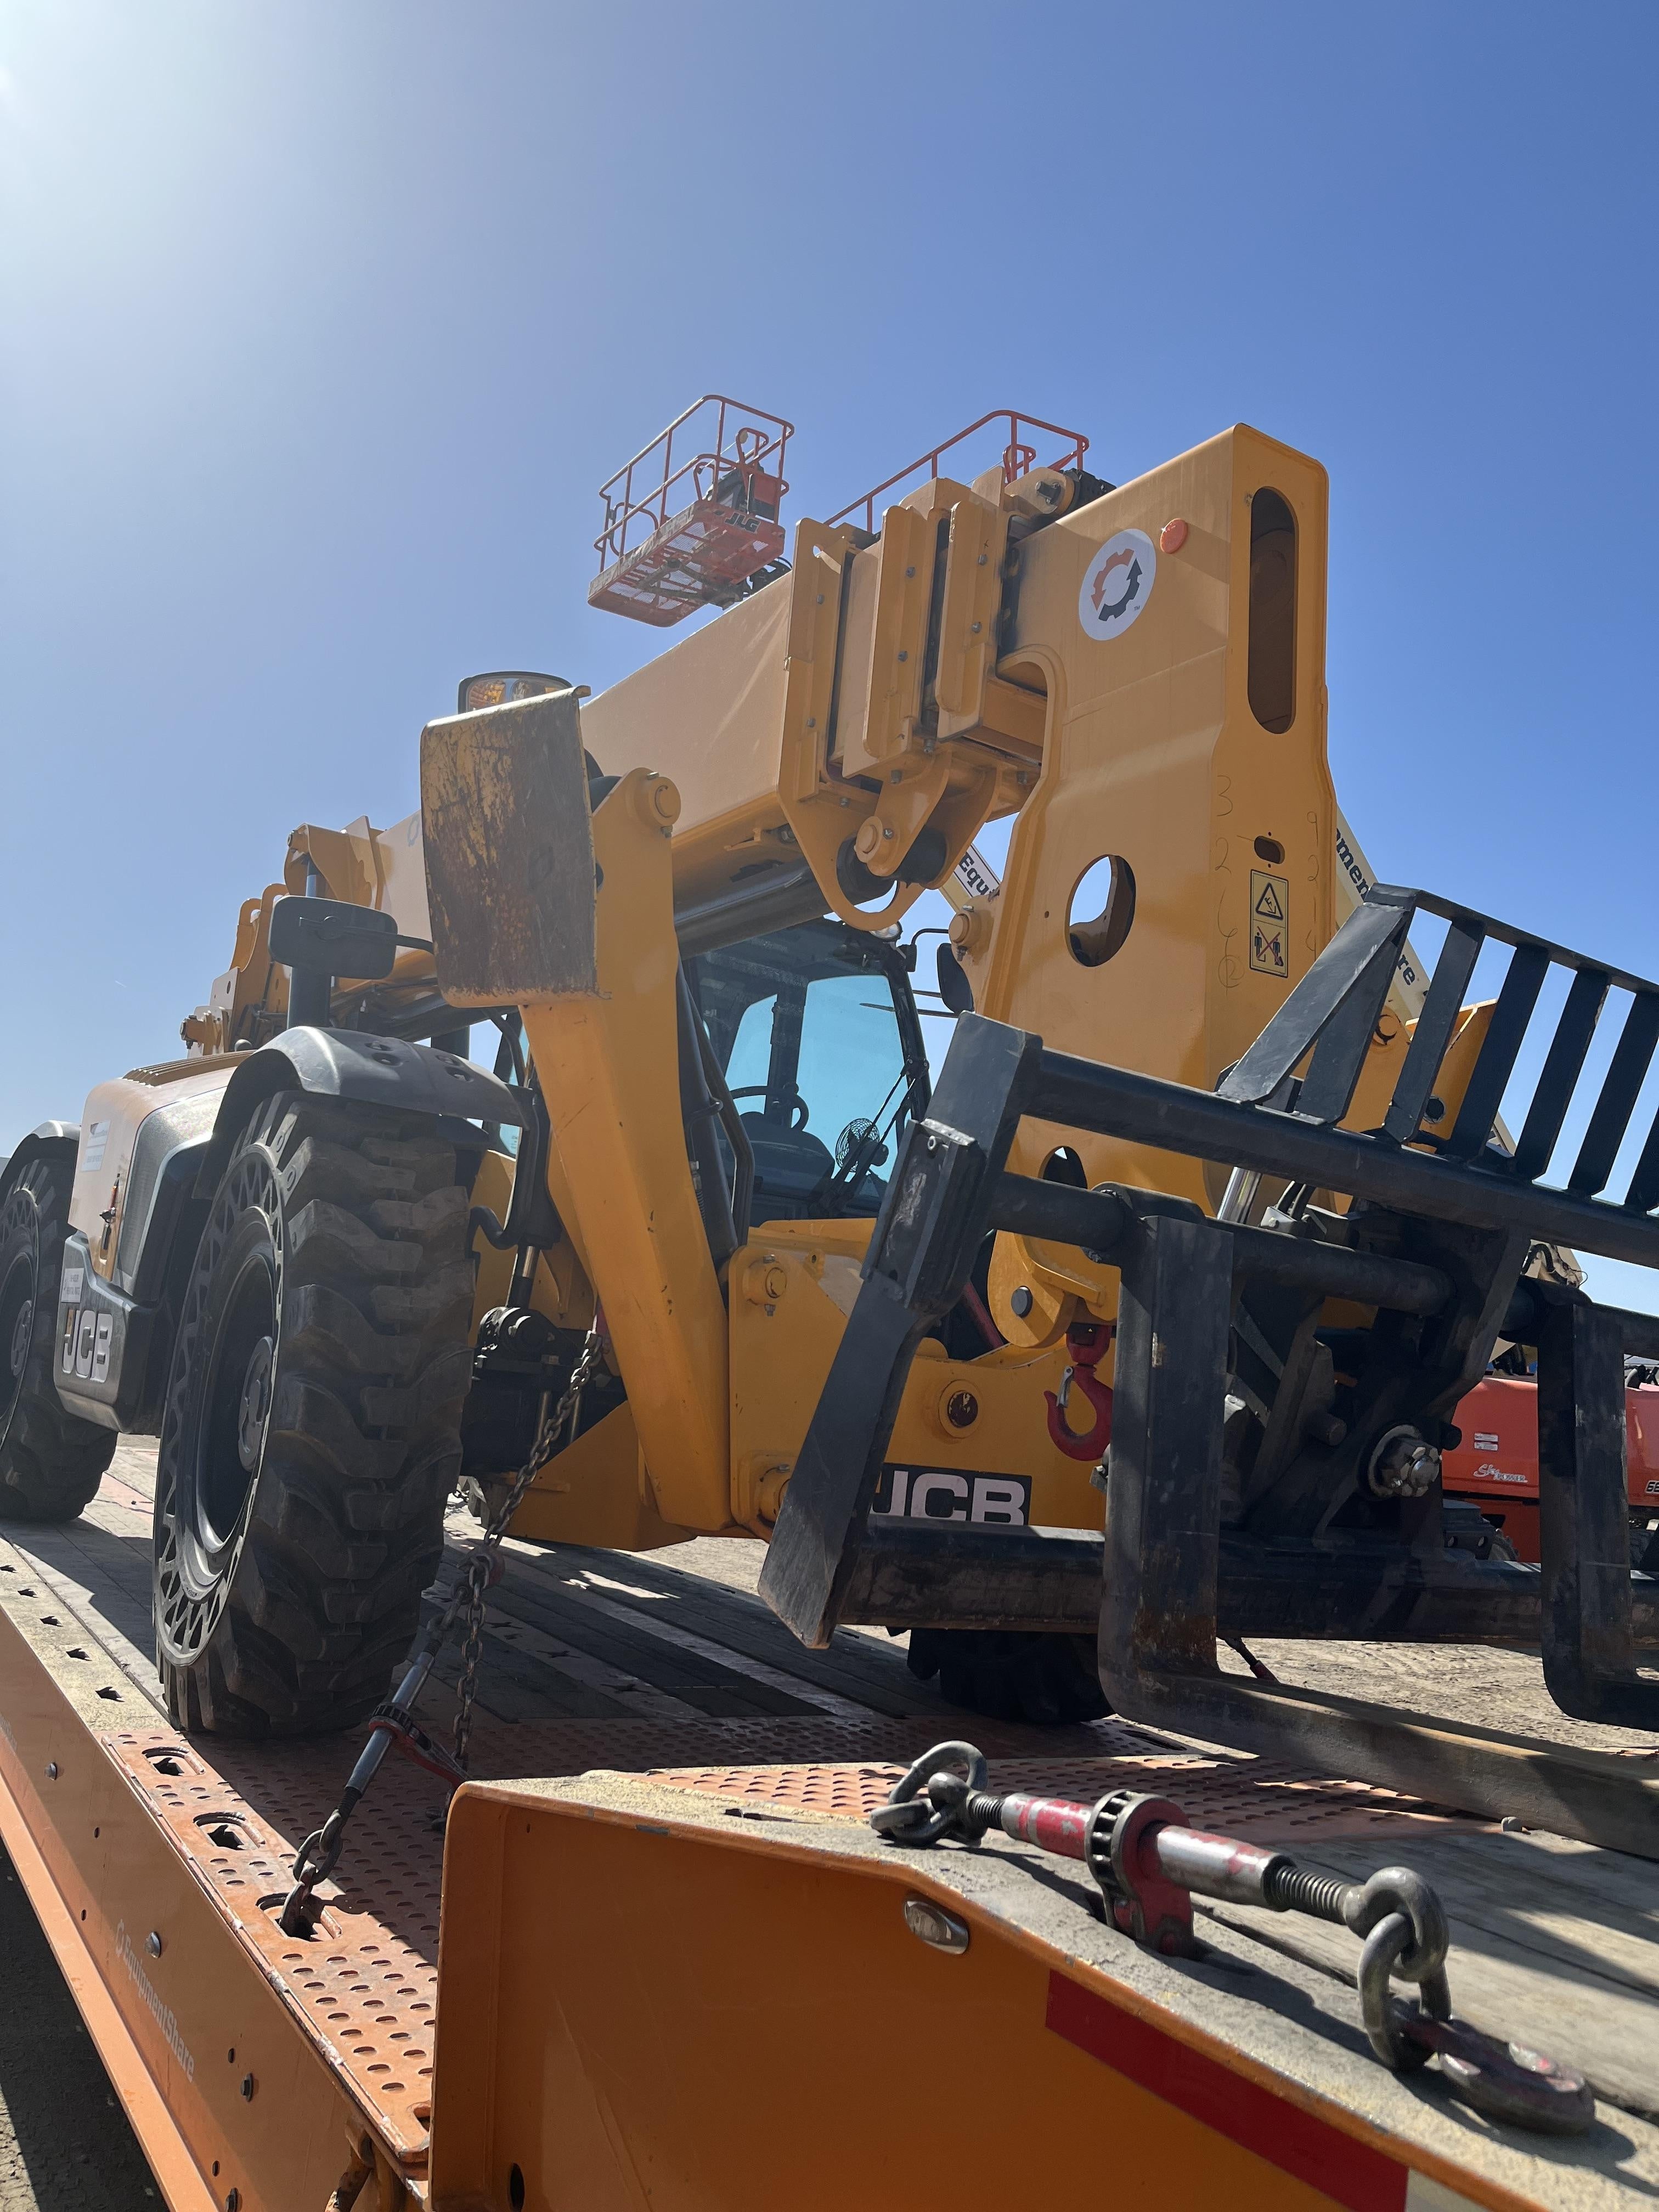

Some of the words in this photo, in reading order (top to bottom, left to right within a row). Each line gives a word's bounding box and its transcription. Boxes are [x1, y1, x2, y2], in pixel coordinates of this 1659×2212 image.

[725, 511, 761, 534] JLG
[1336, 828, 1369, 901] men
[62, 1308, 114, 1384] JCB
[869, 1470, 1025, 1526] JCB
[122, 1933, 195, 2084] EquipmentShare
